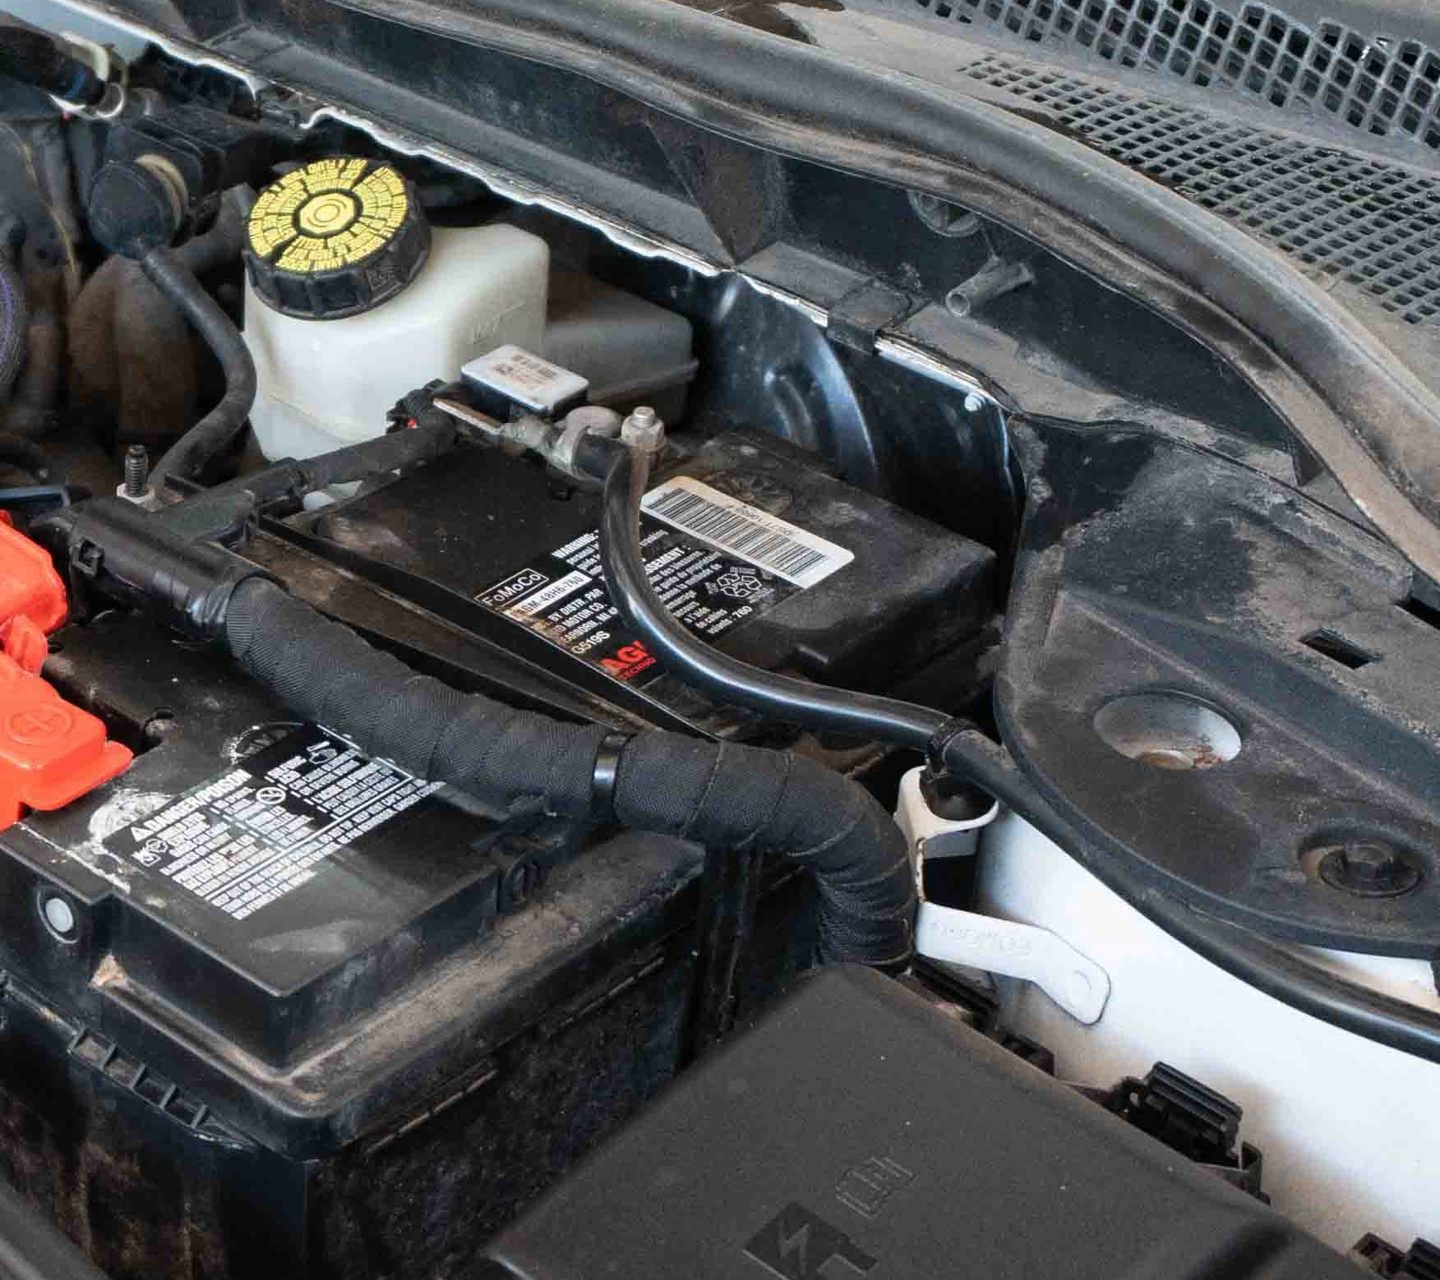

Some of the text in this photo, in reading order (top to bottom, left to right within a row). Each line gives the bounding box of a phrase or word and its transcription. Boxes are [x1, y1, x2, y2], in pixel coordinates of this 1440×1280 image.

[481, 572, 542, 606] FoMoCo
[731, 605, 754, 618] 760
[570, 631, 611, 655] G519S
